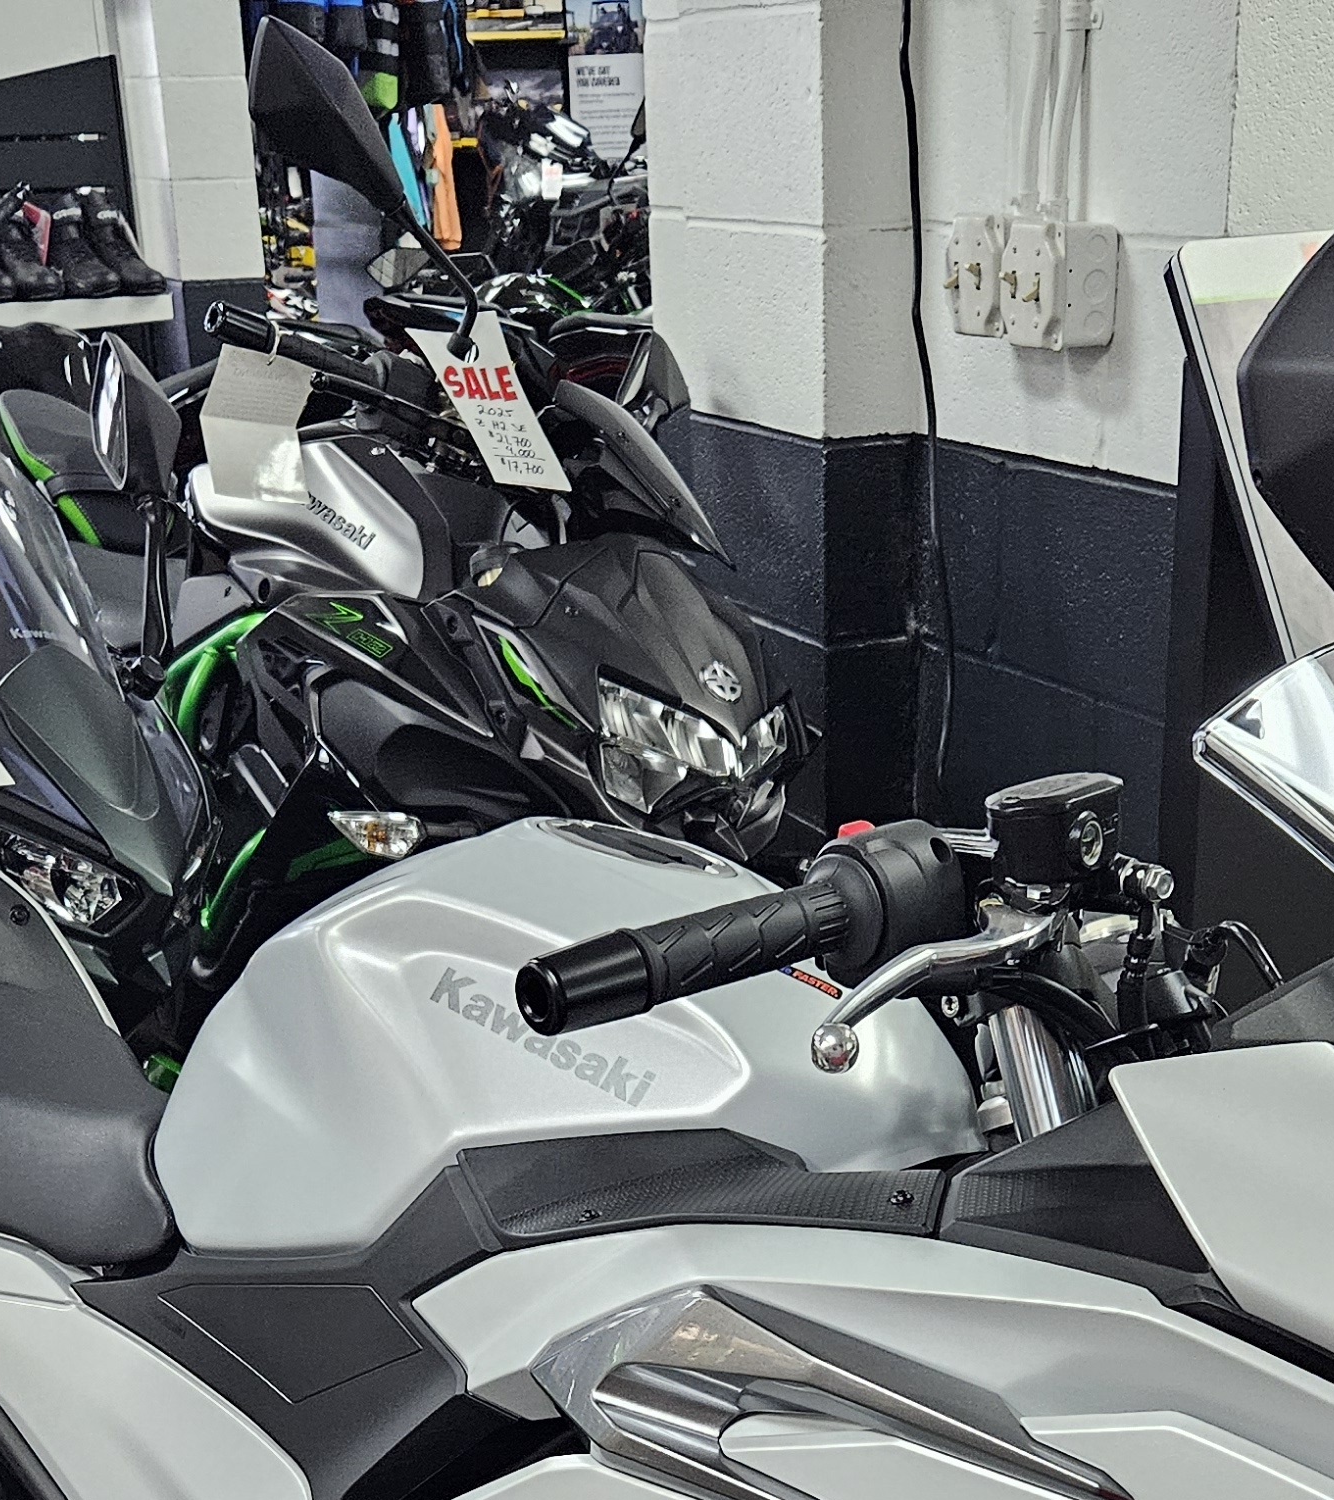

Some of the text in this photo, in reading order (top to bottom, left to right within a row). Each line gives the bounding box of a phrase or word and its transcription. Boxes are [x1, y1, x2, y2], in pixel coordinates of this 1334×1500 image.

[443, 365, 518, 402] SALE
[477, 405, 514, 418] 2025
[492, 421, 507, 431] H2
[429, 966, 657, 1108] Kawasaki
